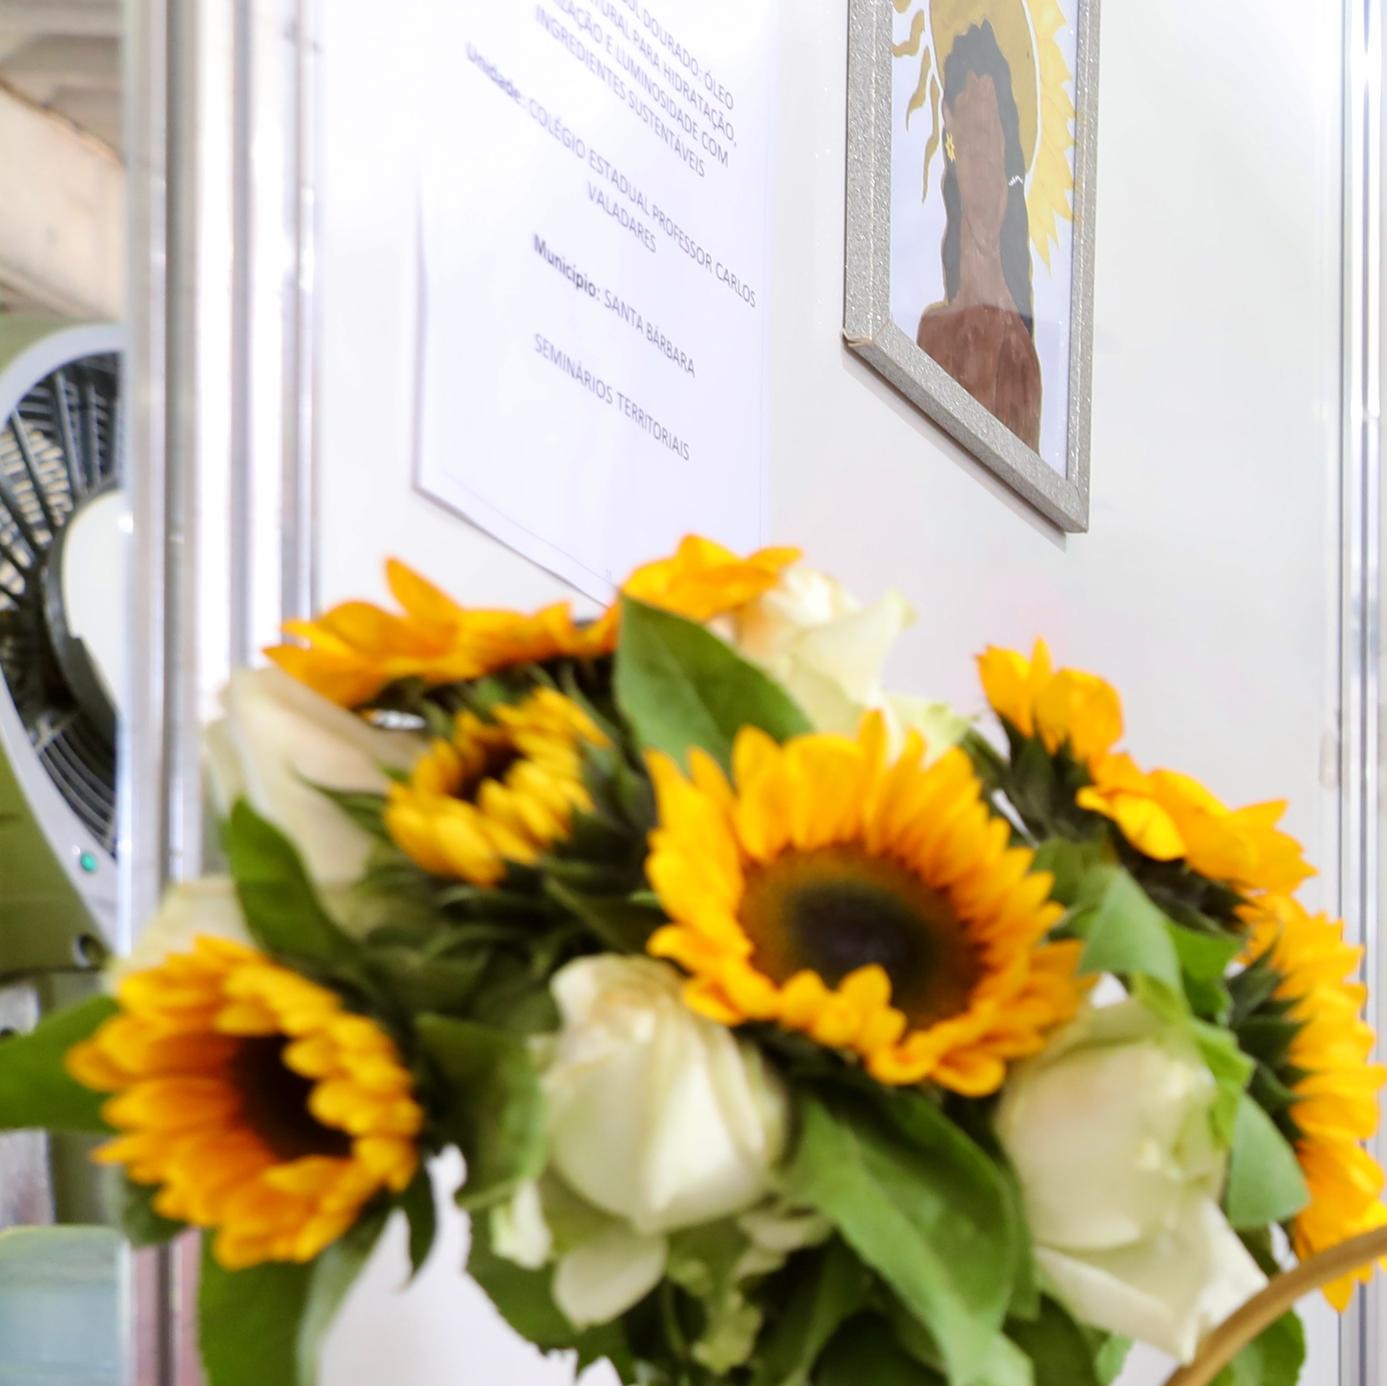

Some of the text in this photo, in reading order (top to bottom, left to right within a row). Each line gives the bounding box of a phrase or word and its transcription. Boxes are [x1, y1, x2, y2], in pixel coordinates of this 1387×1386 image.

[616, 46, 699, 141] LUMINOSIDADE
[701, 130, 729, 168] COM
[704, 69, 734, 110] ÓLEO
[629, 91, 705, 178] SUSTENTÁVEIS
[587, 181, 657, 254] VALADARES
[589, 149, 651, 217] ESTADUAL
[652, 204, 713, 274] PROFESSOR
[715, 262, 757, 309] CARLOS
[604, 289, 644, 335] SANTA
[646, 321, 695, 378] BÁRBARA
[534, 332, 691, 463] SEMINÁRIOS TERRITORIAIS
